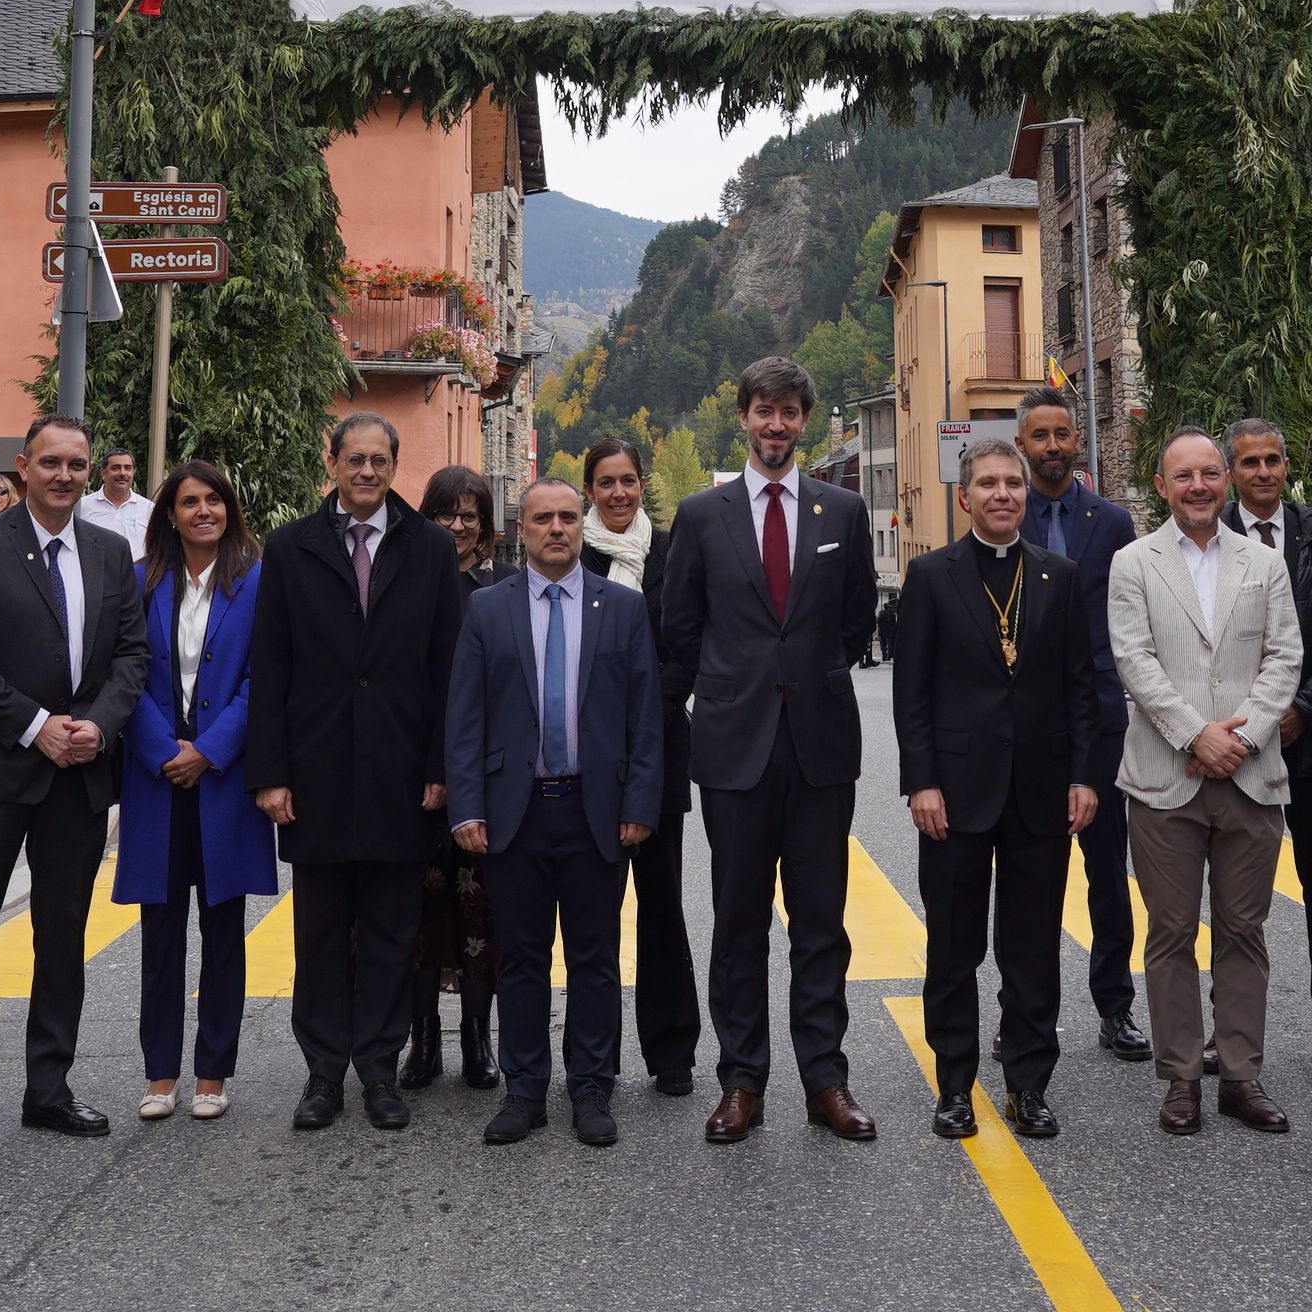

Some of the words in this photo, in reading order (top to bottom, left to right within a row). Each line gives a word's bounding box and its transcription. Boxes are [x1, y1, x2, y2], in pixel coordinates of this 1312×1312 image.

[133, 191, 193, 205] Església
[198, 192, 216, 203] de
[139, 204, 174, 216] Sant
[178, 204, 215, 216] Cerni
[130, 250, 213, 268] Rectoria
